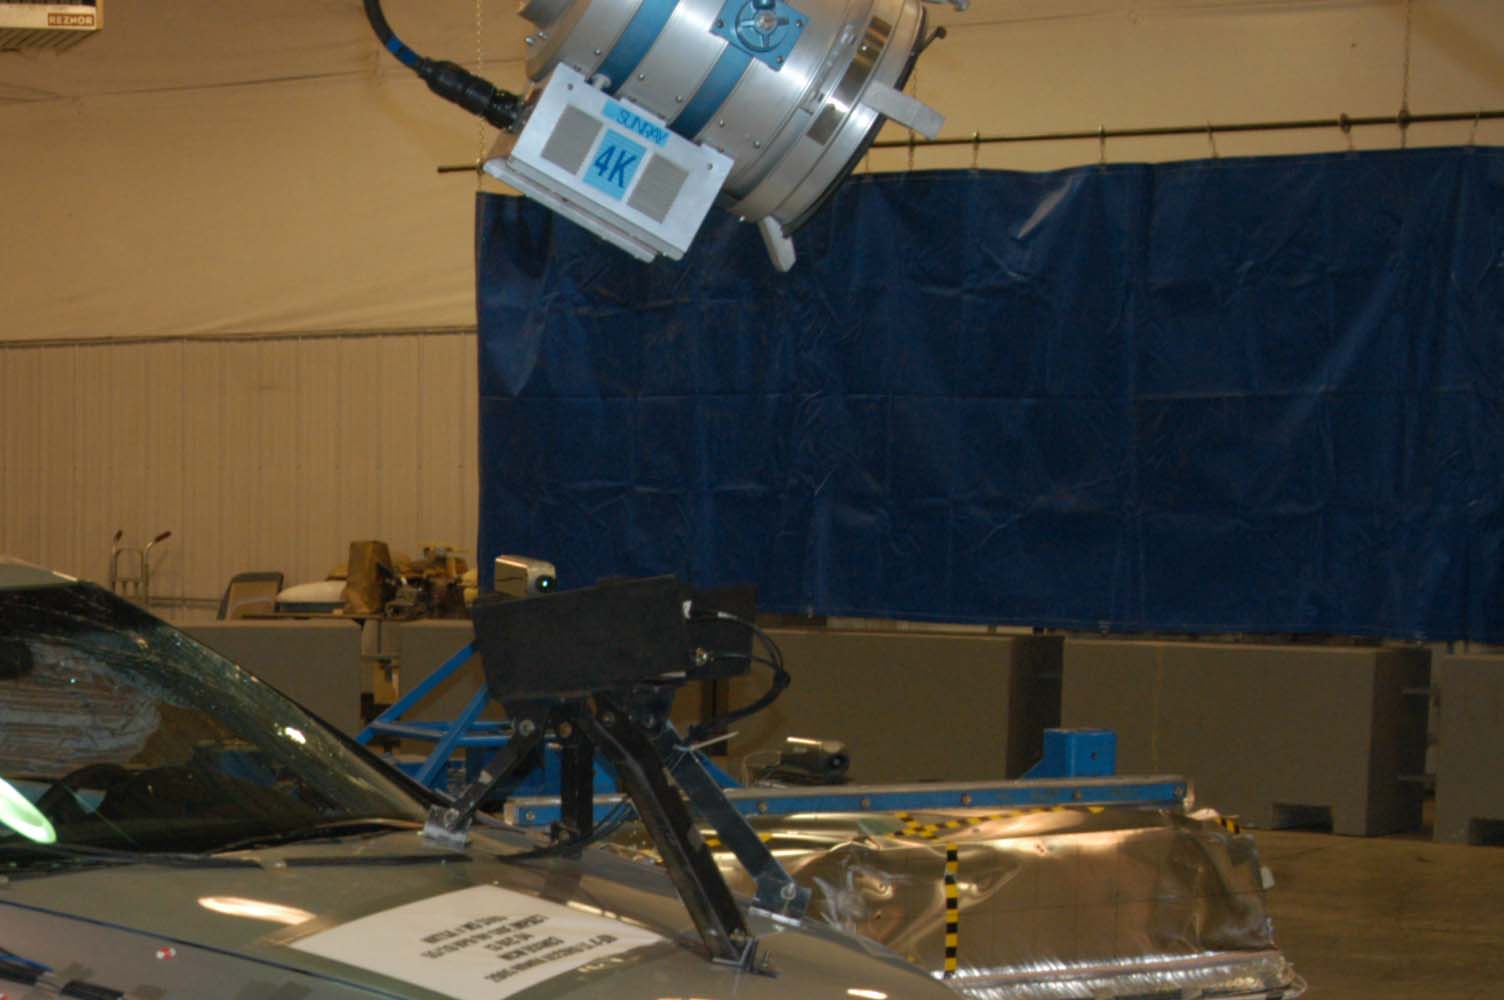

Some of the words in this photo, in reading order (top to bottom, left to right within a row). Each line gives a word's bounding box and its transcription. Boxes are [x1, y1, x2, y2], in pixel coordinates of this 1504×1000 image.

[49, 15, 93, 25] REZNOR
[617, 108, 670, 145] SUNRAY
[594, 146, 636, 188] 4K
